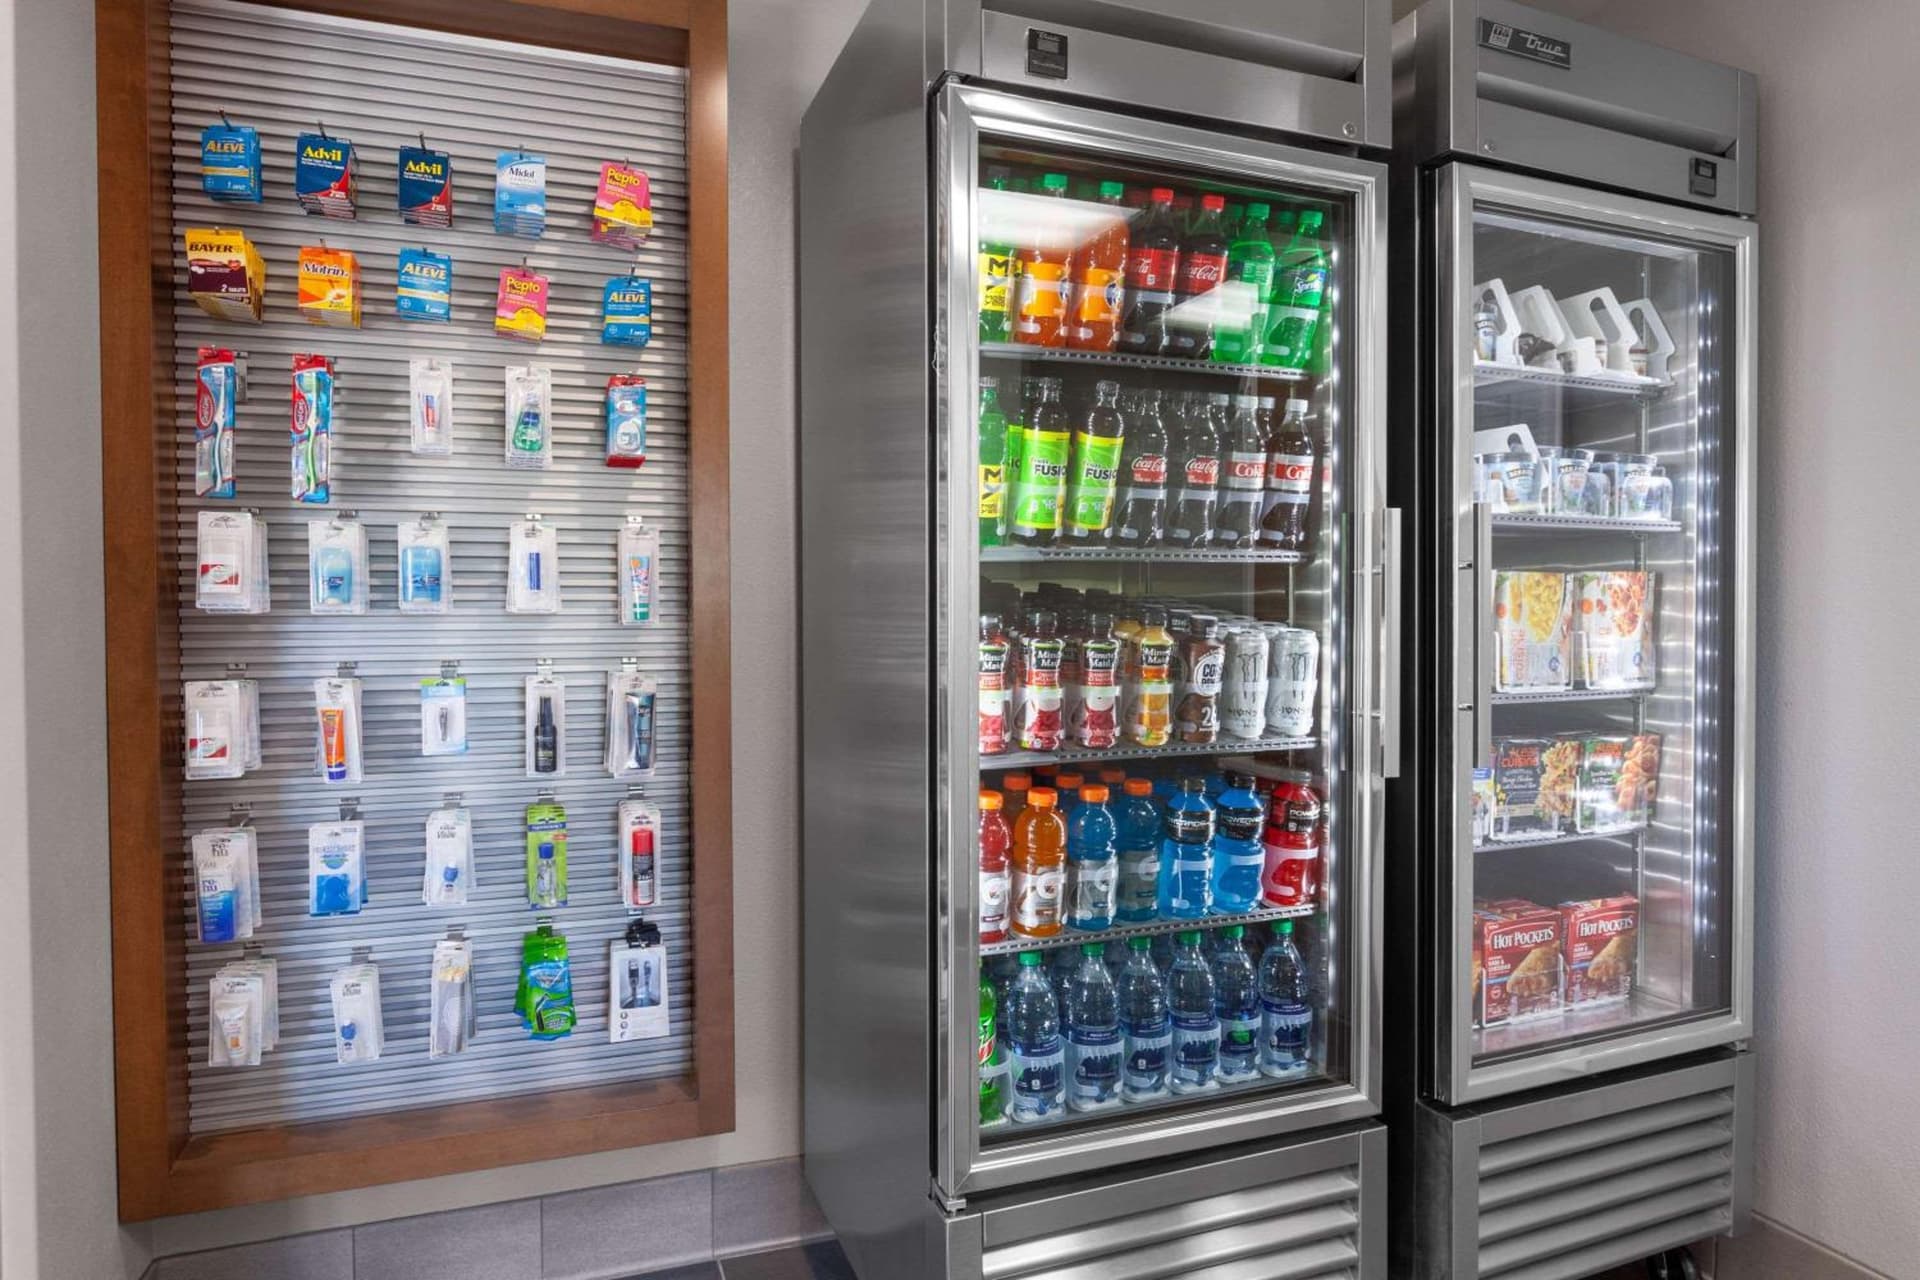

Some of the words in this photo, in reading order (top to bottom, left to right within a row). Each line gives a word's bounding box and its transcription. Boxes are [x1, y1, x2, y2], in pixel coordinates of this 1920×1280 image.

[204, 139, 245, 153] ALEVE
[303, 145, 342, 162] Advil
[404, 159, 442, 175] Advil
[606, 167, 641, 188] Pepto
[189, 242, 233, 252] BAYER
[303, 262, 346, 278] Motrin
[401, 263, 448, 280] ALEVE
[221, 283, 228, 293] 2
[506, 276, 541, 296] Pepto
[607, 291, 646, 303] ALEVE
[1580, 922, 1598, 937] HOT
[1598, 915, 1634, 933] POCKETS
[1493, 932, 1513, 950] HOT
[1514, 926, 1555, 946] POCKETS
